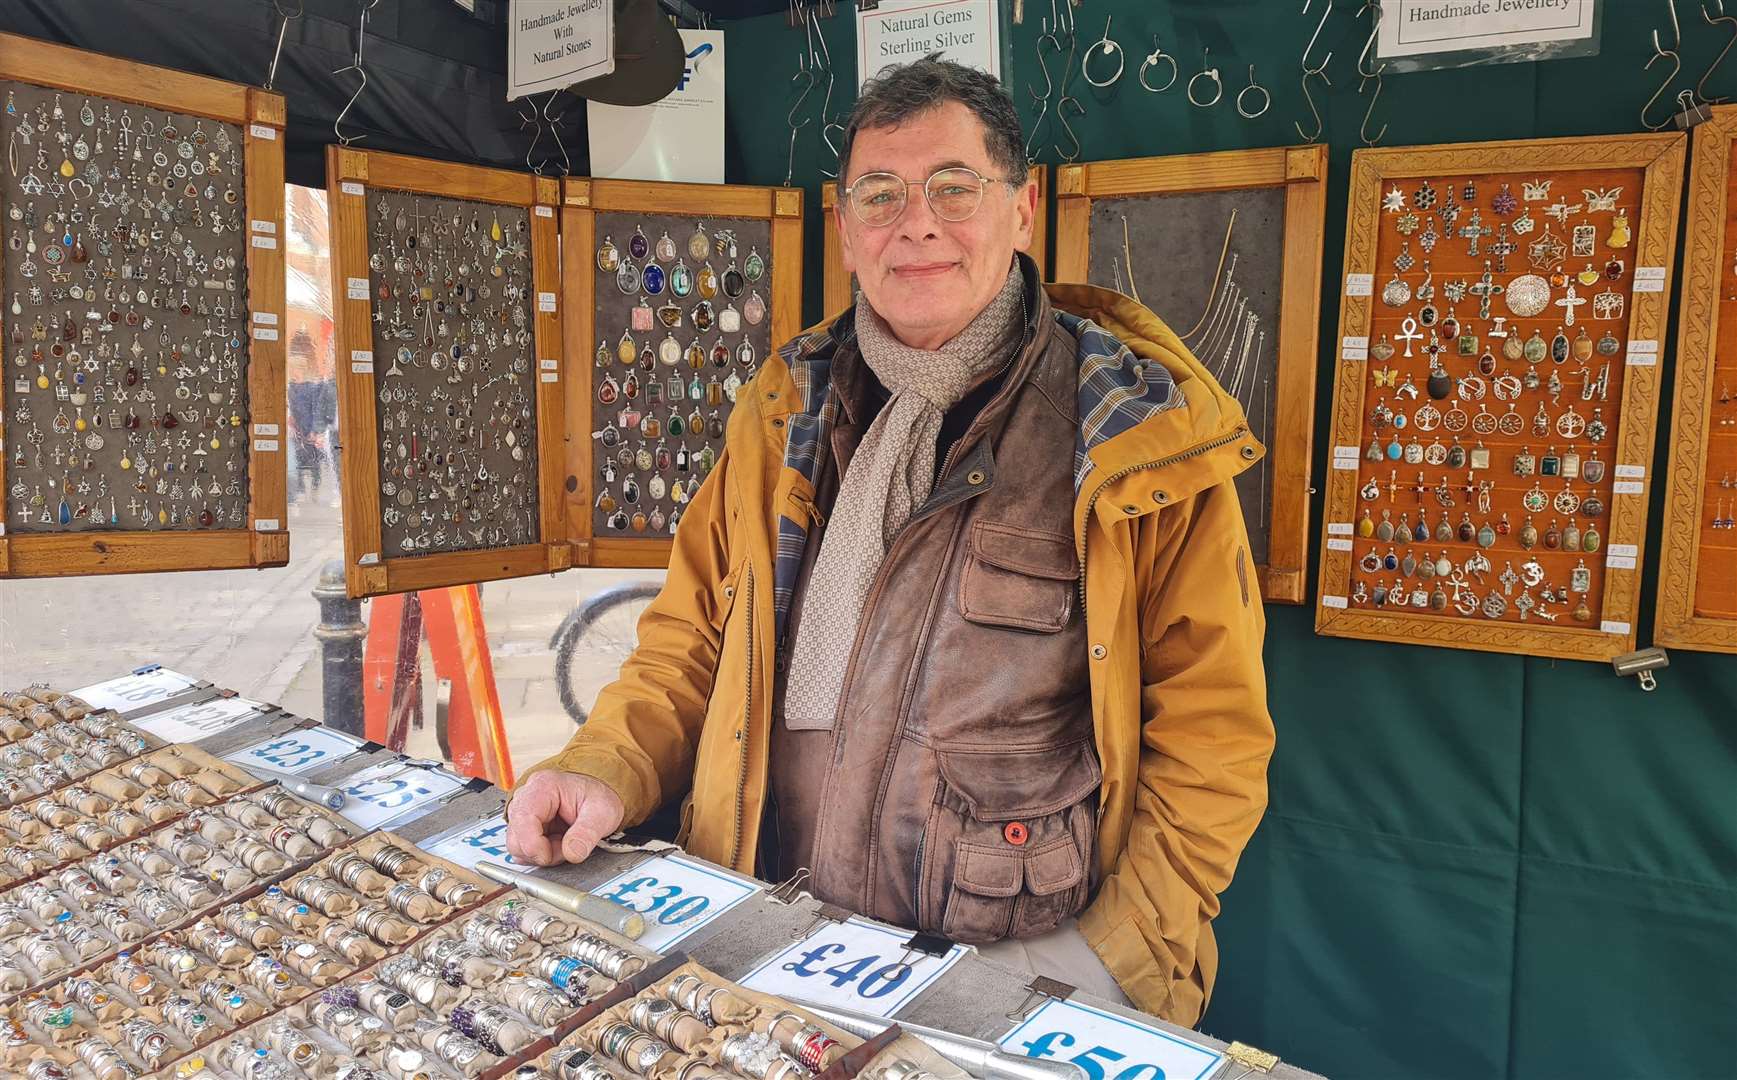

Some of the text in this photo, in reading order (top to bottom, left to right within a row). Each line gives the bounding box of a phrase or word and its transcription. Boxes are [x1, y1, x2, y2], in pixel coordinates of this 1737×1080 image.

[520, 9, 565, 31] Handmade
[881, 10, 972, 33] Natural Gems
[1409, 1, 1490, 22] Handmade
[554, 24, 574, 40] With
[534, 39, 592, 64] Natural Stones
[880, 32, 975, 56] Sterling Silver
[107, 680, 167, 701] £18
[250, 740, 325, 767] £23
[600, 877, 709, 925] £30
[782, 943, 912, 998] £40
